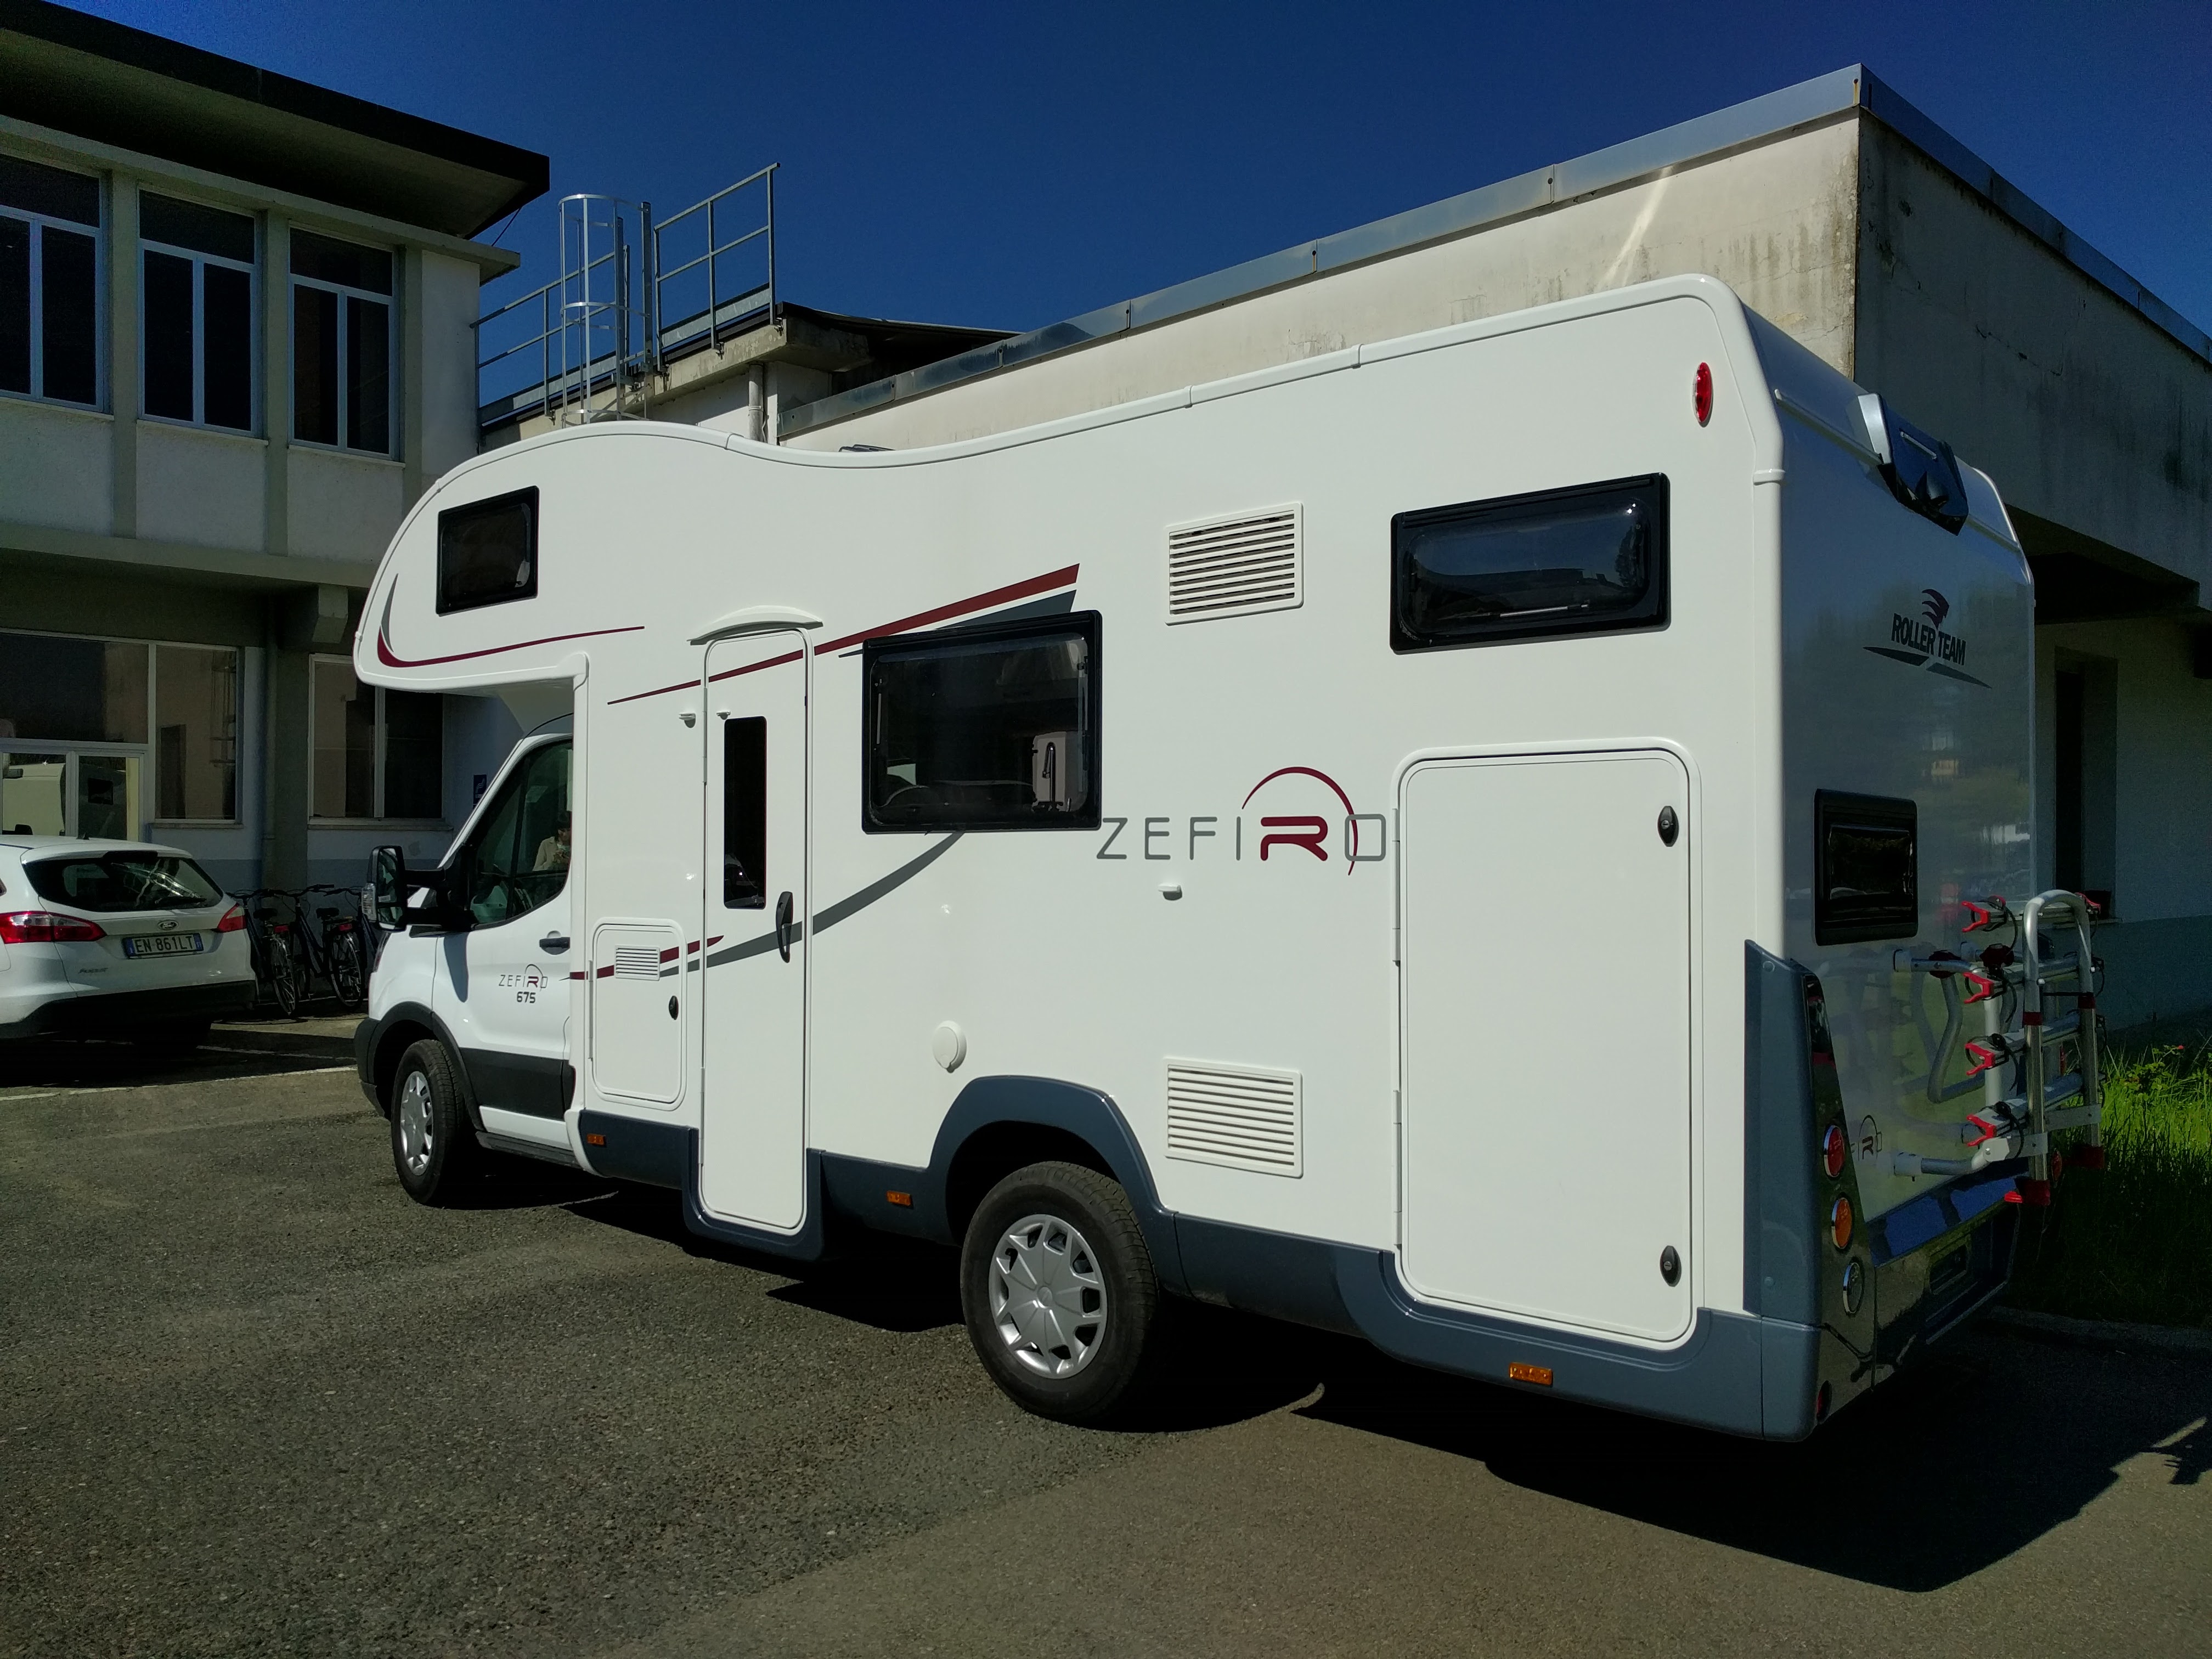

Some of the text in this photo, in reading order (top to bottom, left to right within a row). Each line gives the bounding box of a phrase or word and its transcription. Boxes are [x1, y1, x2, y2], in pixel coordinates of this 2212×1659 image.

[1891, 613, 1967, 665] ROLLER TEAM
[1096, 814, 1386, 861] ZEFIRO
[135, 939, 152, 953] EN
[156, 936, 193, 951] 861LT
[499, 974, 548, 989] ZEFIRO
[517, 991, 536, 1003] 675
